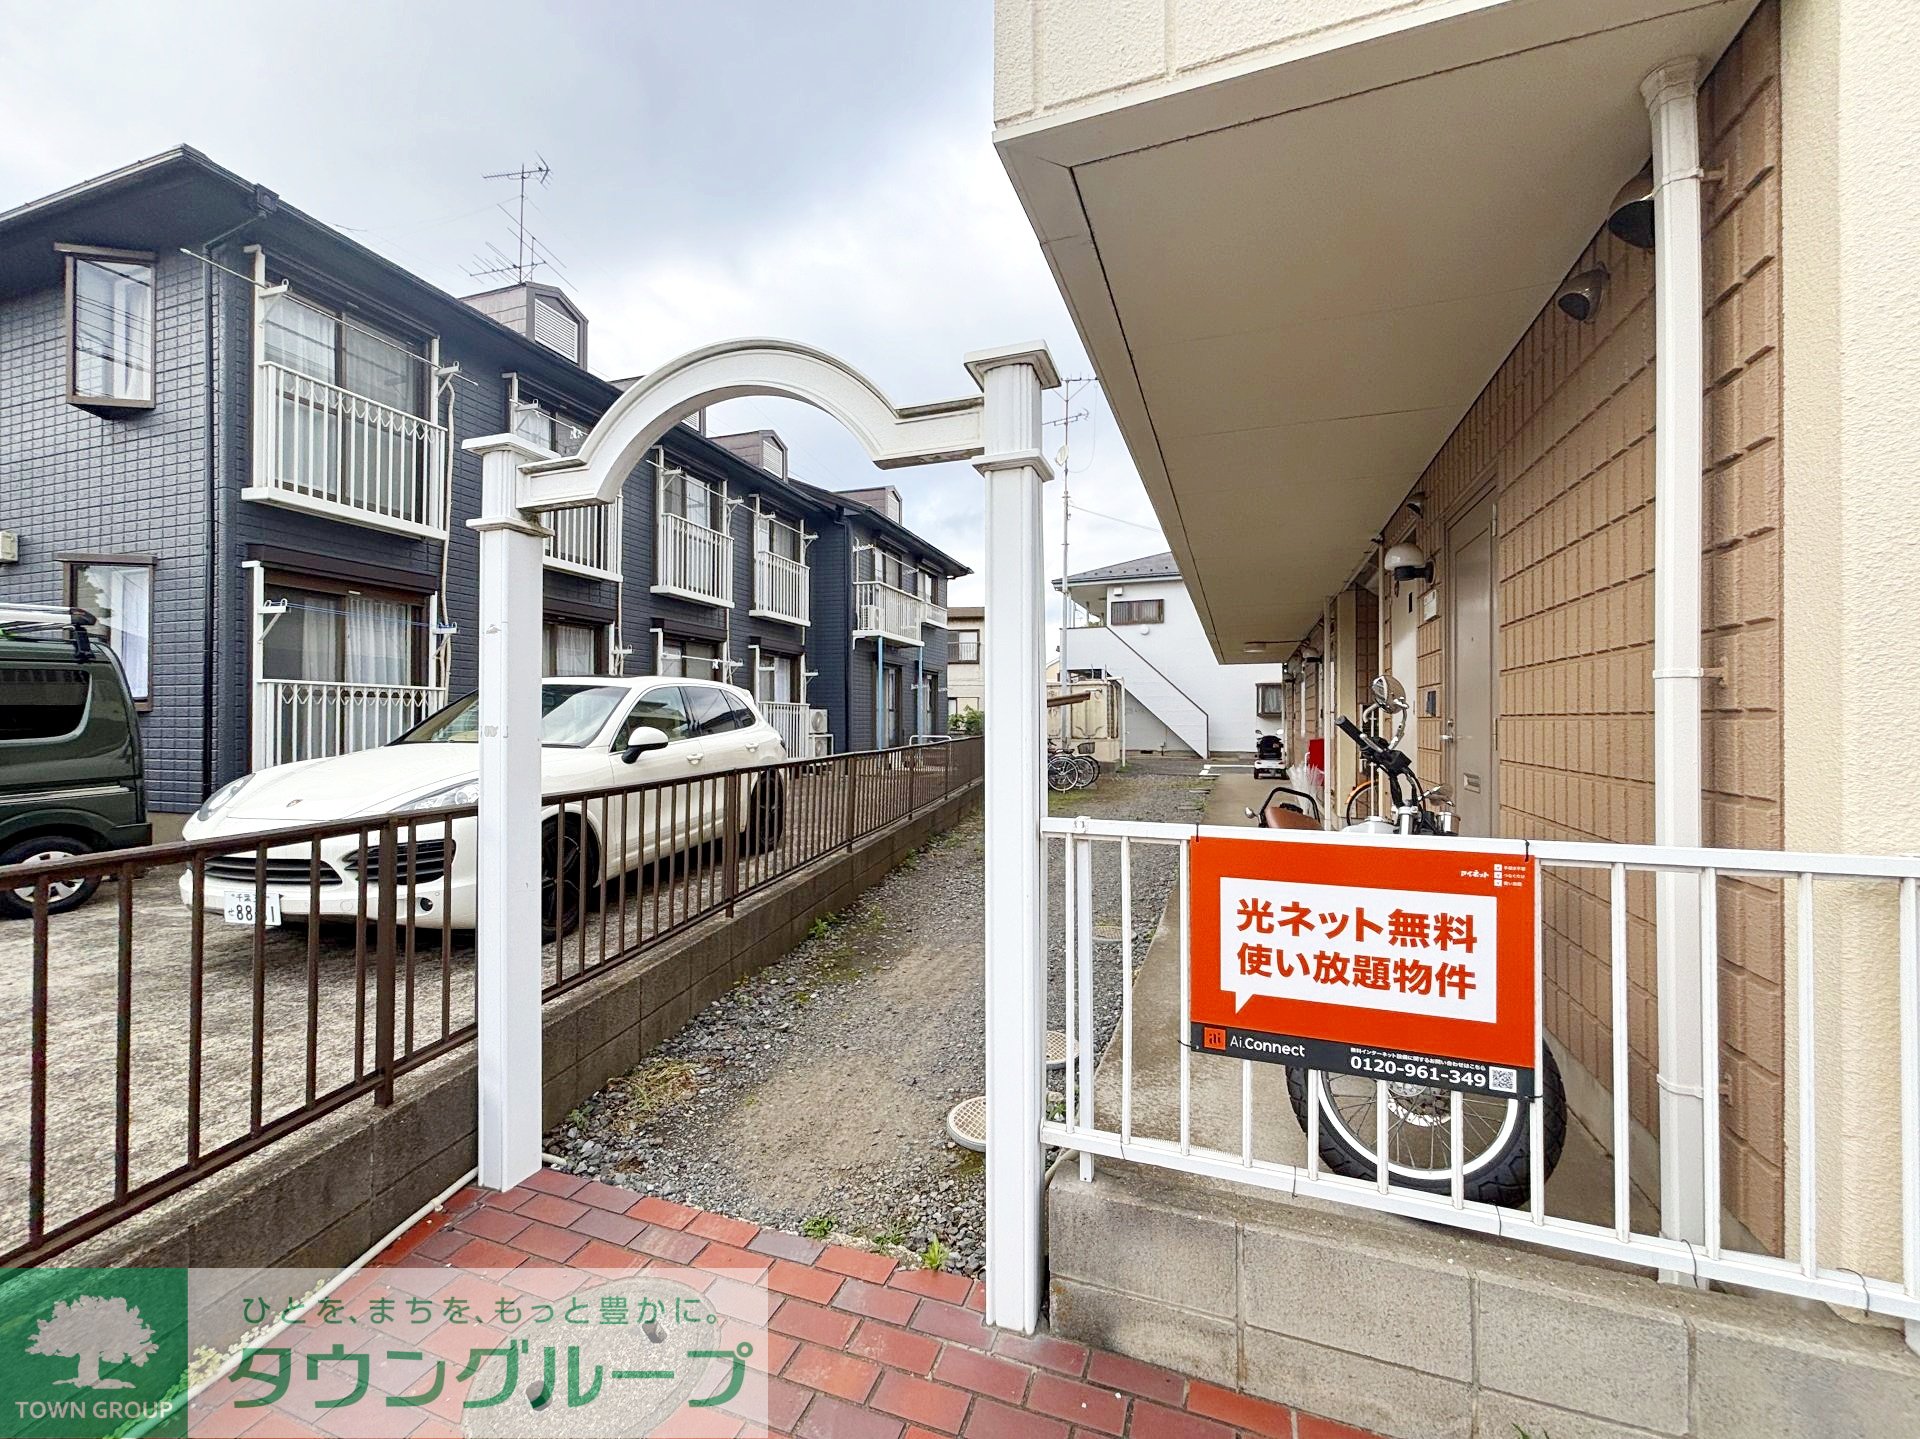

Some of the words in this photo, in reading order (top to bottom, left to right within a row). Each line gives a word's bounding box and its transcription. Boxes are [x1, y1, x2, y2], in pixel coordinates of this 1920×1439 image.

[236, 904, 275, 922] 881
[1236, 897, 1478, 954] 光ネット無料
[1236, 942, 1477, 1000] 使い放題物件
[1350, 1056, 1487, 1087] 0120-961-349
